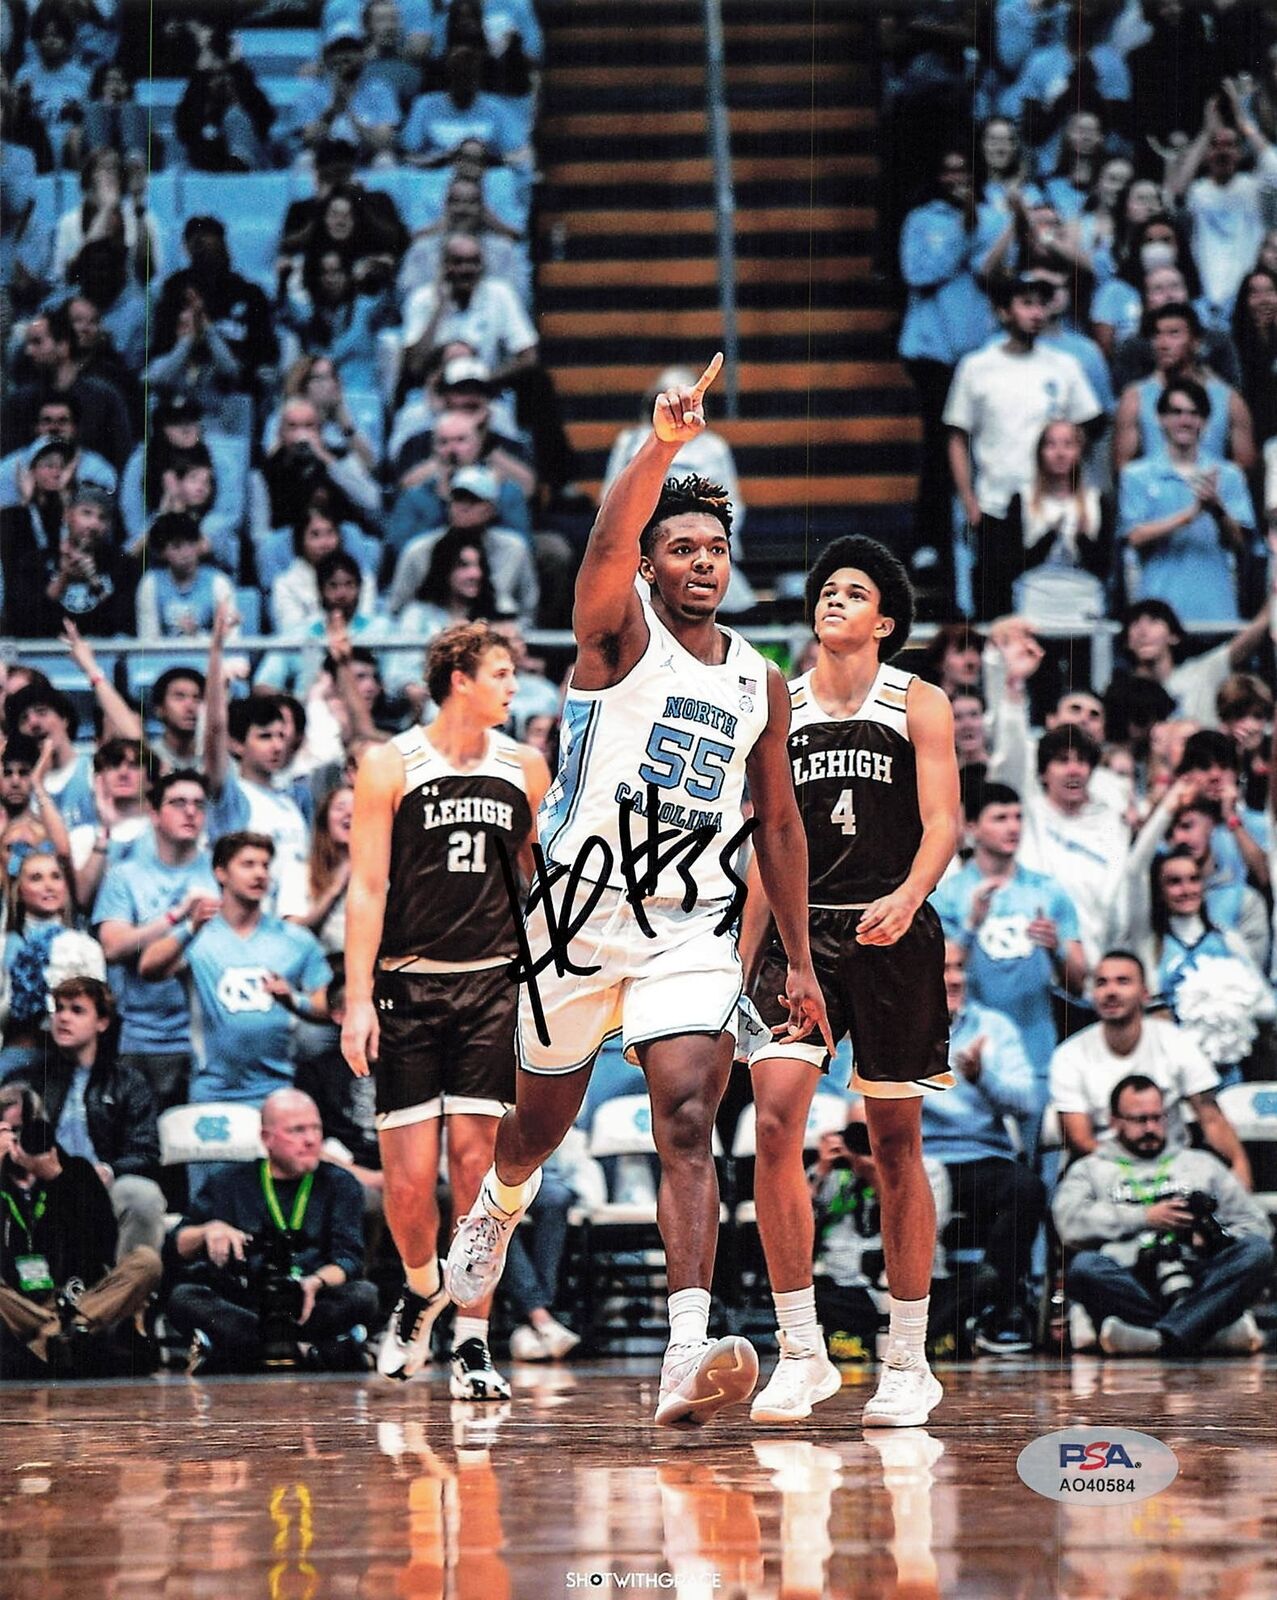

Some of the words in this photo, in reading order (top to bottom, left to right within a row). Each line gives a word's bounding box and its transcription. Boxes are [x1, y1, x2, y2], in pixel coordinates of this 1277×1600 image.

[662, 696, 738, 739] NORTH
[638, 722, 735, 802] 55
[792, 749, 893, 786] LEHIGH
[423, 797, 513, 830] LEHIGH
[614, 782, 723, 832] CAOLINA
[830, 788, 856, 835] 4
[447, 830, 486, 873] 21
[1059, 1478, 1136, 1492] AO40584
